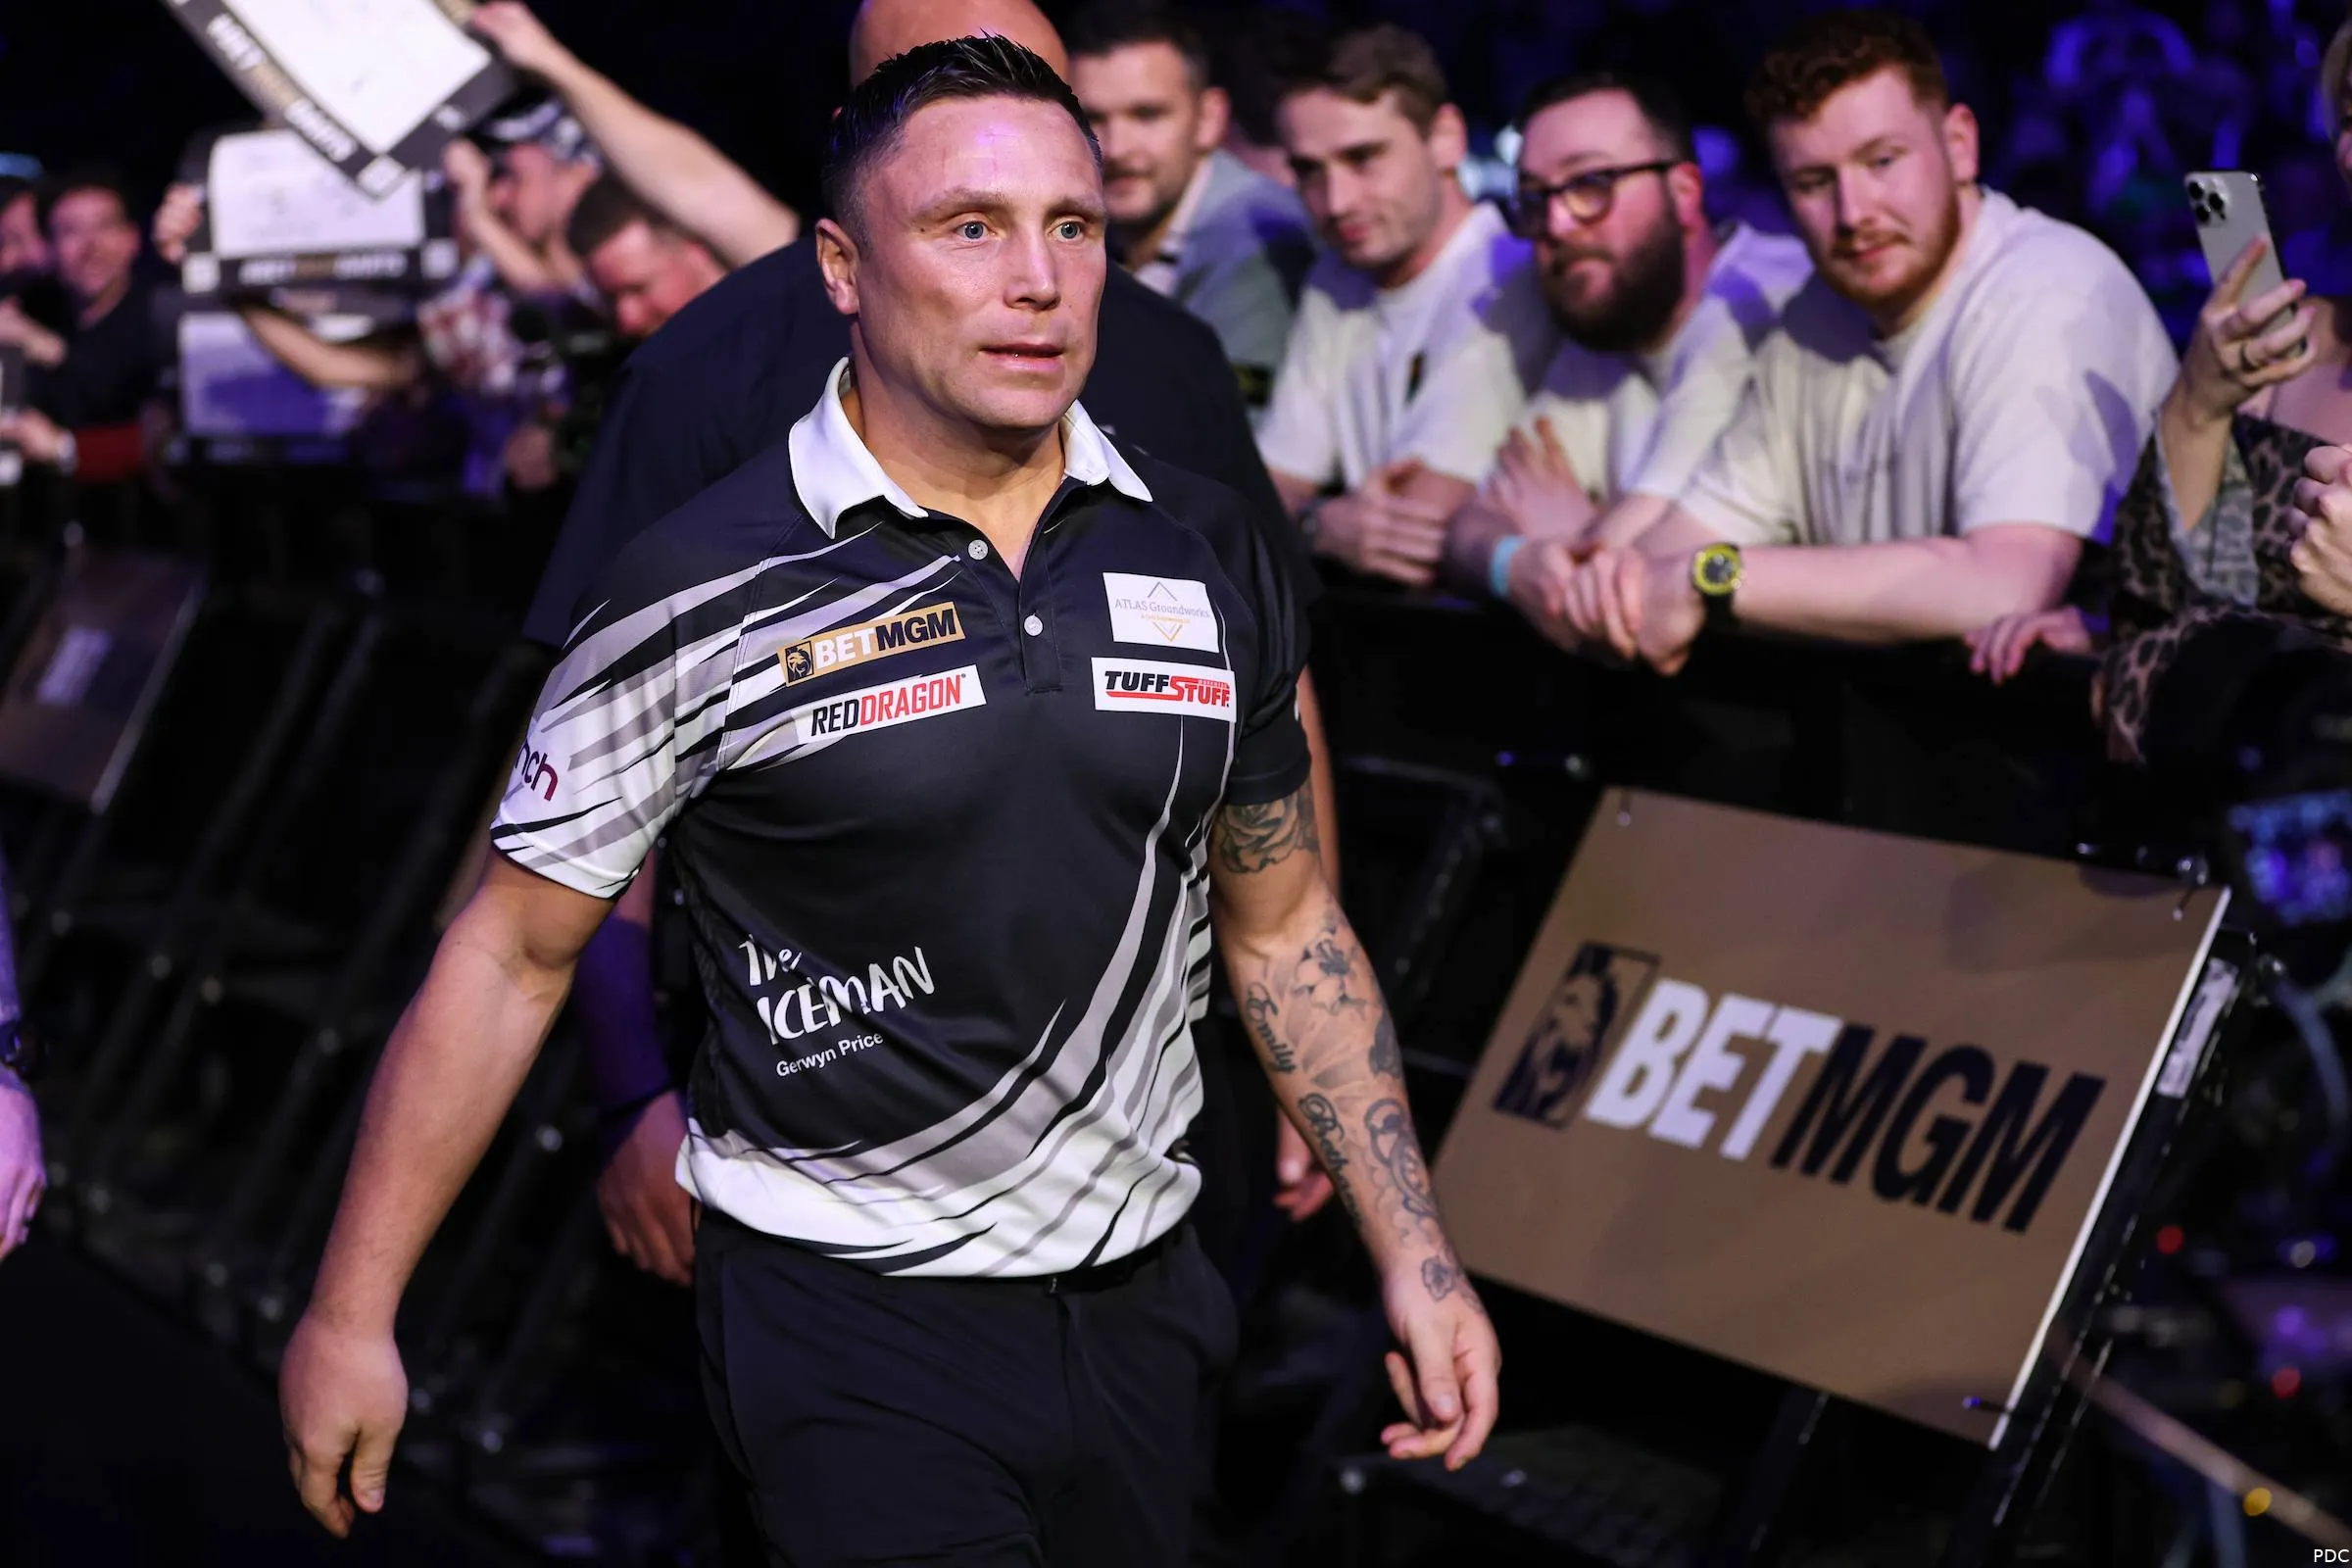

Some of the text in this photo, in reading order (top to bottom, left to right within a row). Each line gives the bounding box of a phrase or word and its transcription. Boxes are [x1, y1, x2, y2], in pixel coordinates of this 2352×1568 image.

[1114, 598, 1211, 618] ATLAS Groundworks
[813, 609, 957, 669] BETMGM
[514, 740, 559, 802] nch
[757, 946, 935, 1046] ICEMAN
[776, 1032, 883, 1077] Gerwyn Price
[1583, 976, 2107, 1235] BETMGM
